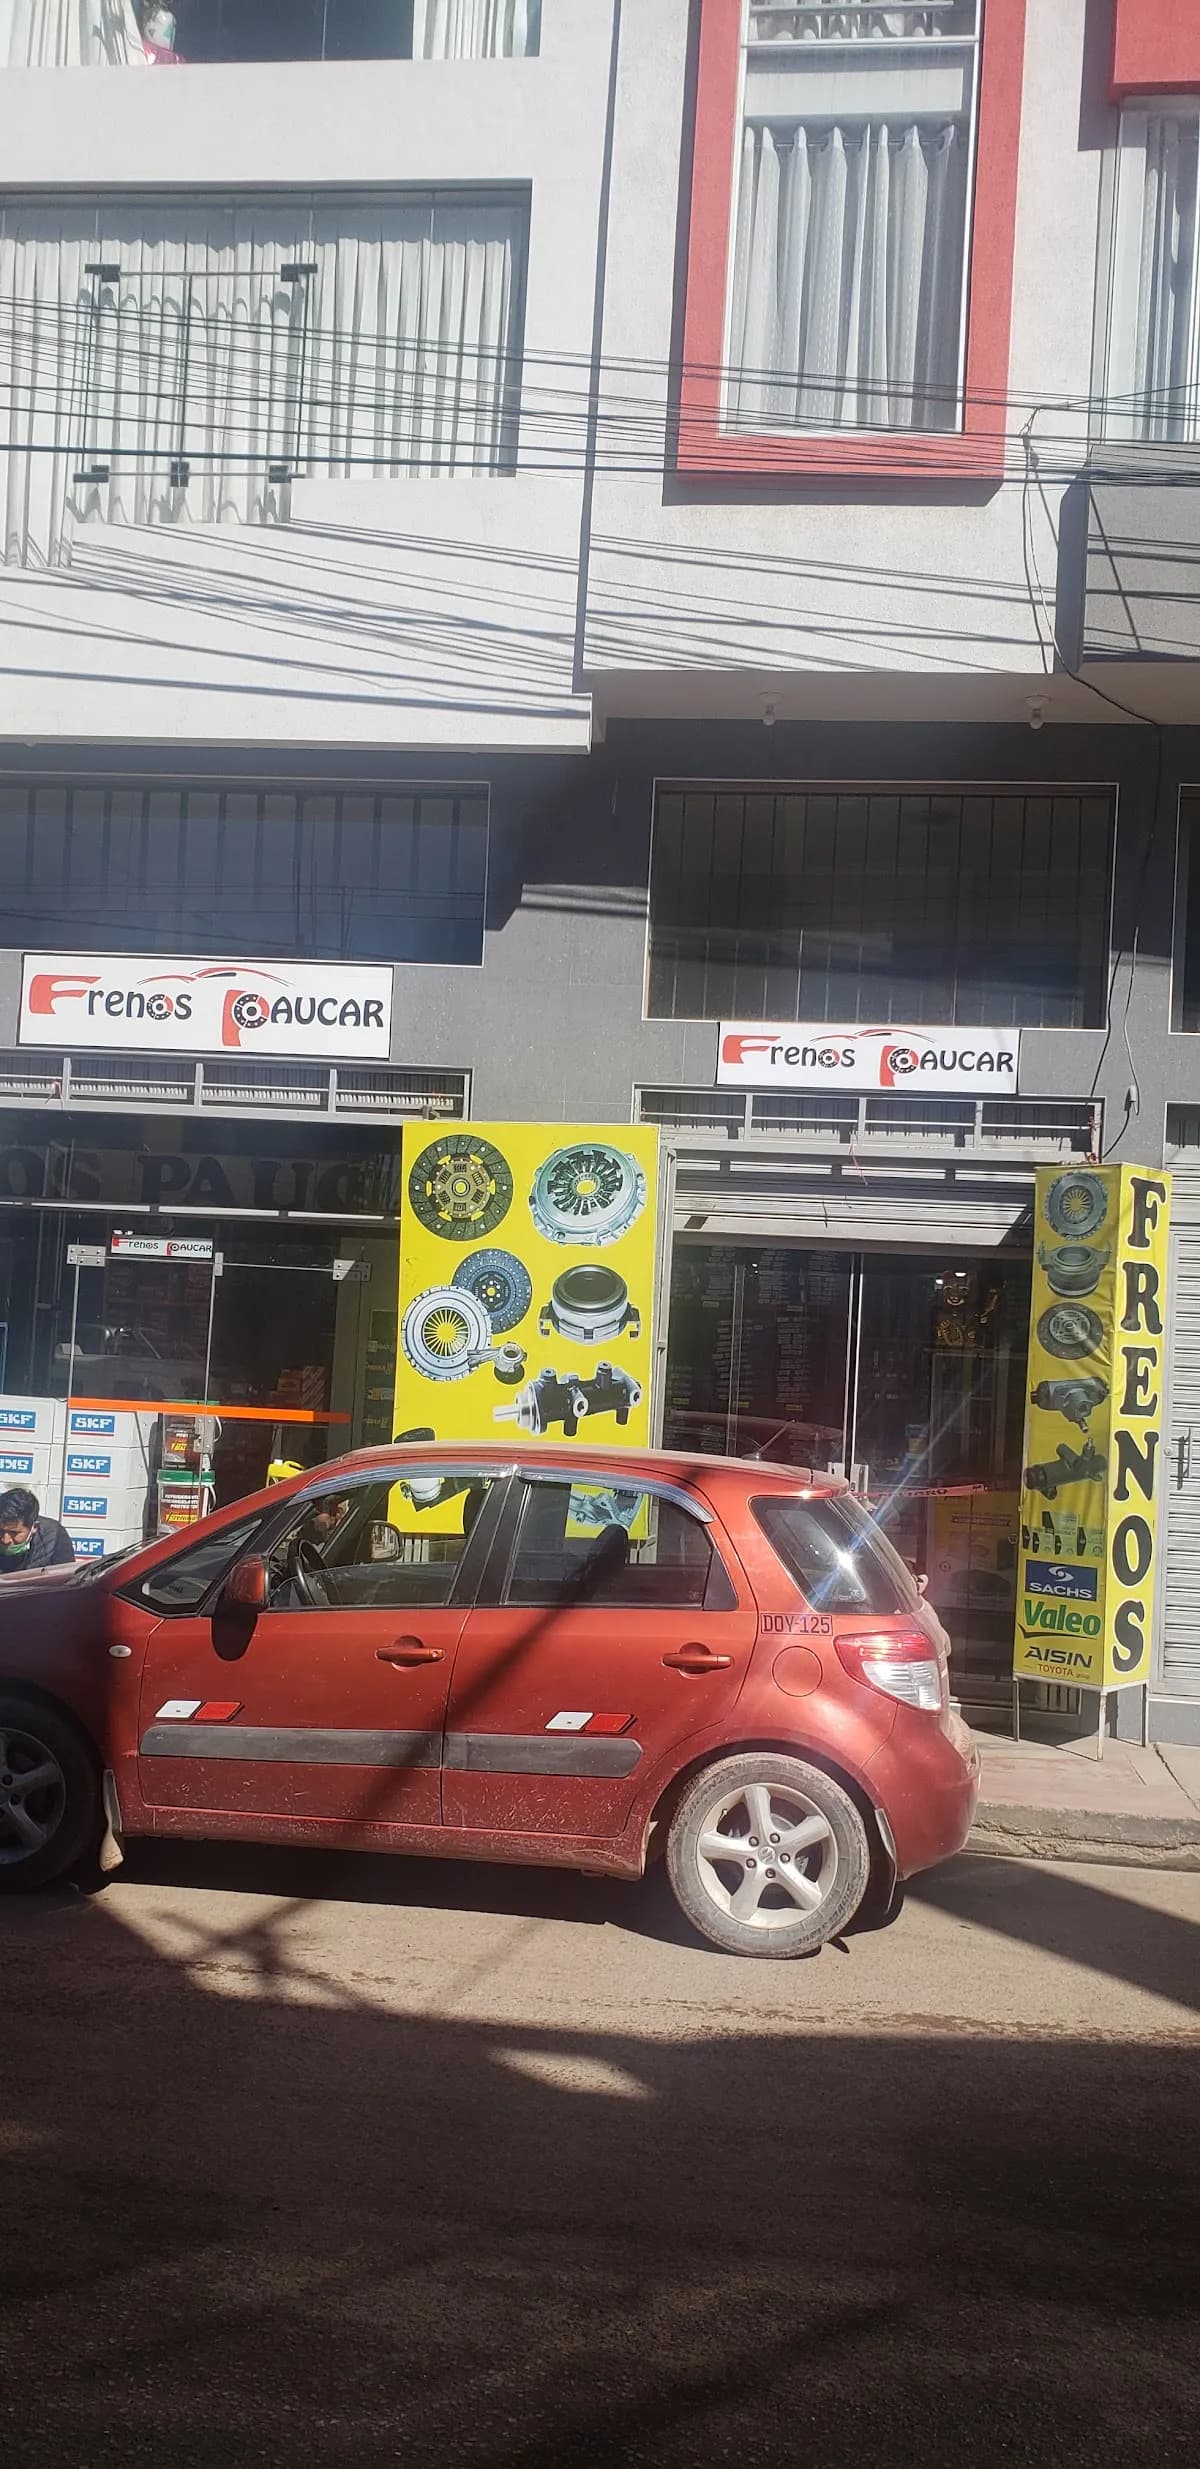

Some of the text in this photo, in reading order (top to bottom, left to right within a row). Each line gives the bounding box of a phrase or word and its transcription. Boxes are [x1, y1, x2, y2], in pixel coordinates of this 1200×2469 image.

[29, 974, 385, 1047] Frenos PAUCAR
[722, 1035, 1014, 1087] Frenos PAUCAR
[0, 1413, 33, 1425] SKF
[75, 1417, 113, 1429] SKF
[1111, 1177, 1166, 1672] FRENOS
[70, 1458, 109, 1471] SKF
[67, 1499, 104, 1512] SKF
[1029, 1582, 1093, 1599] SACHS
[1024, 1600, 1101, 1636] Valeo
[1024, 1646, 1093, 1668] AISIN
[1037, 1664, 1074, 1677] TOYOTA
